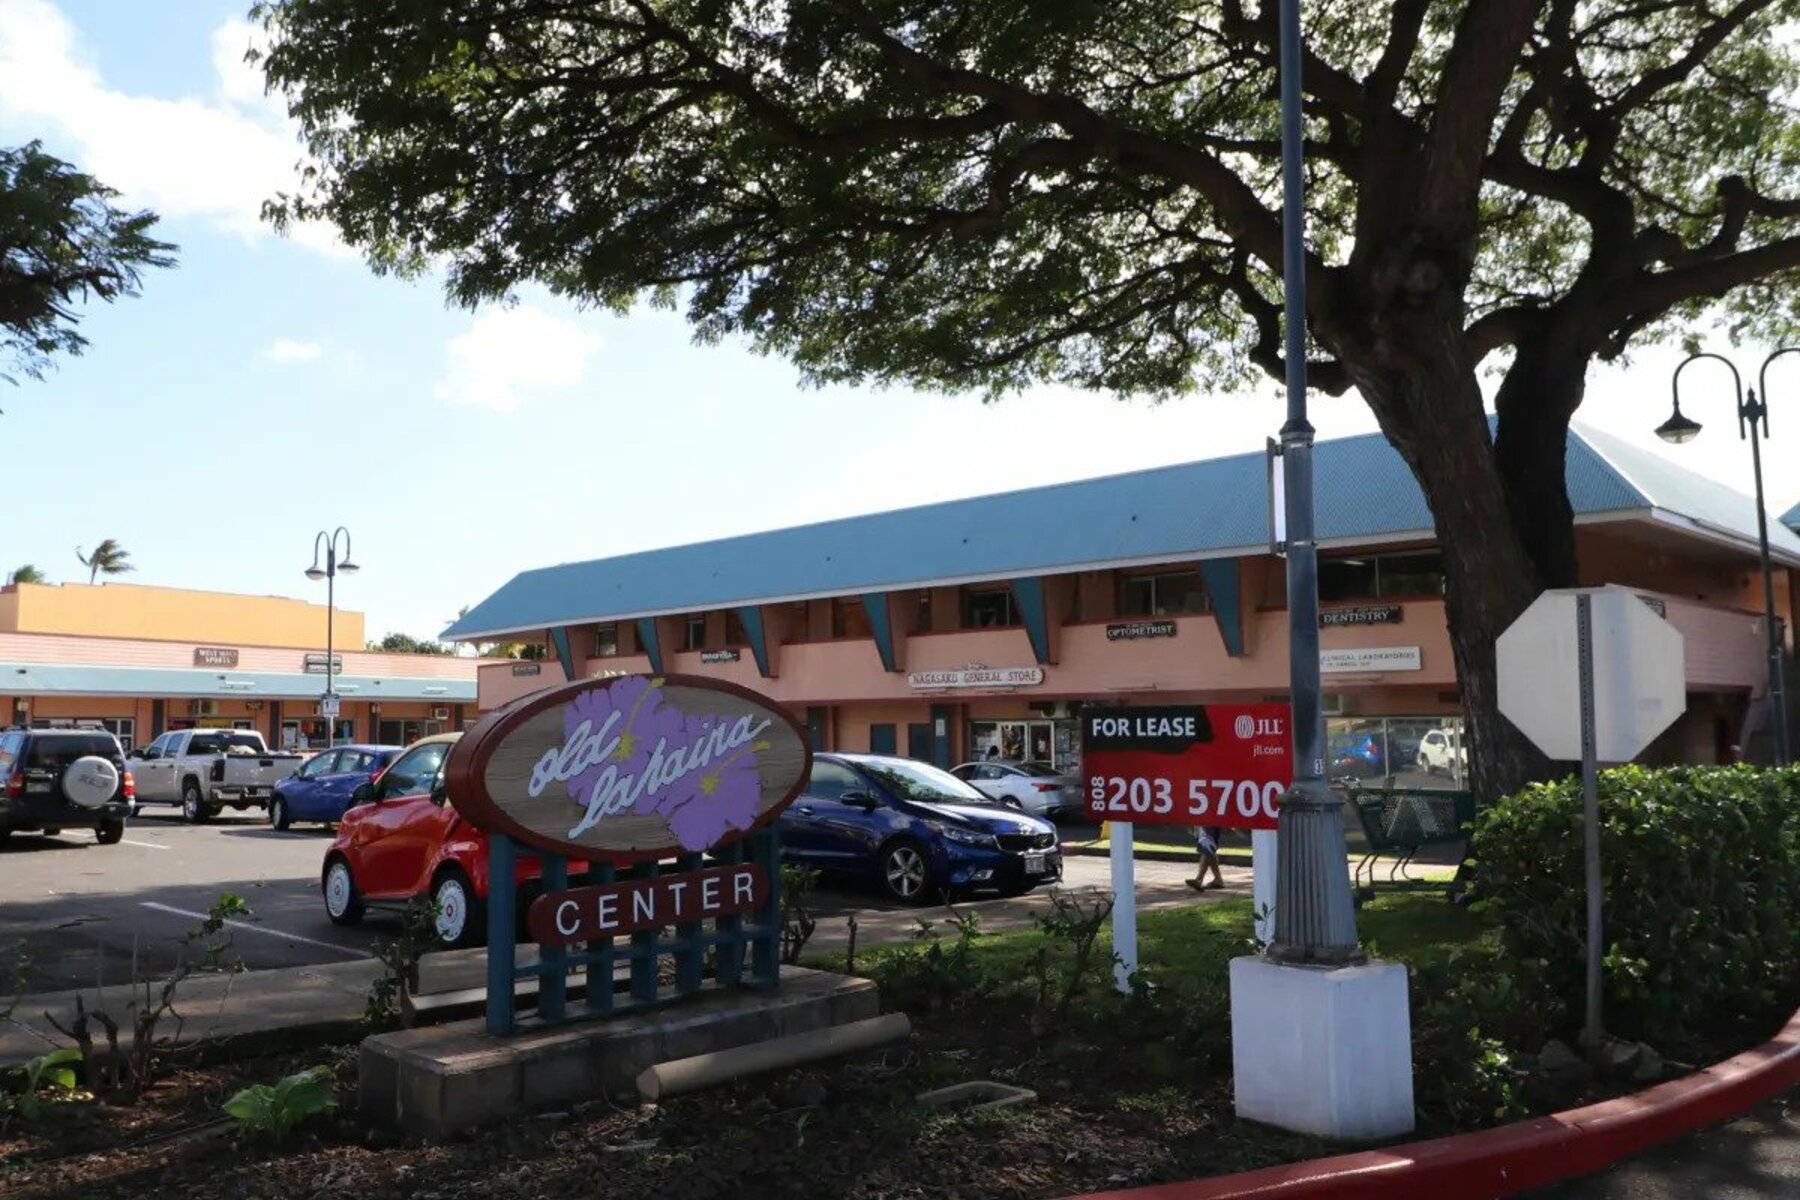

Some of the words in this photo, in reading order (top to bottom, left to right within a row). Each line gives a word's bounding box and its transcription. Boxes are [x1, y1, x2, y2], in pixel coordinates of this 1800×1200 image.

[1323, 610, 1389, 623] DENTISTRY
[1108, 625, 1172, 637] OPTOMETRIST
[912, 673, 958, 685] NAGASAKO
[964, 672, 1001, 684] GENERAL
[1008, 670, 1037, 682] STORE
[1092, 717, 1130, 737] FOR
[1136, 717, 1196, 737] LEASE
[1254, 719, 1284, 736] JLL
[1253, 744, 1284, 757] jll.com
[1091, 776, 1105, 812] 808
[1108, 776, 1173, 814] 203
[1188, 779, 1284, 819] 5700
[556, 872, 753, 935] CENTER
